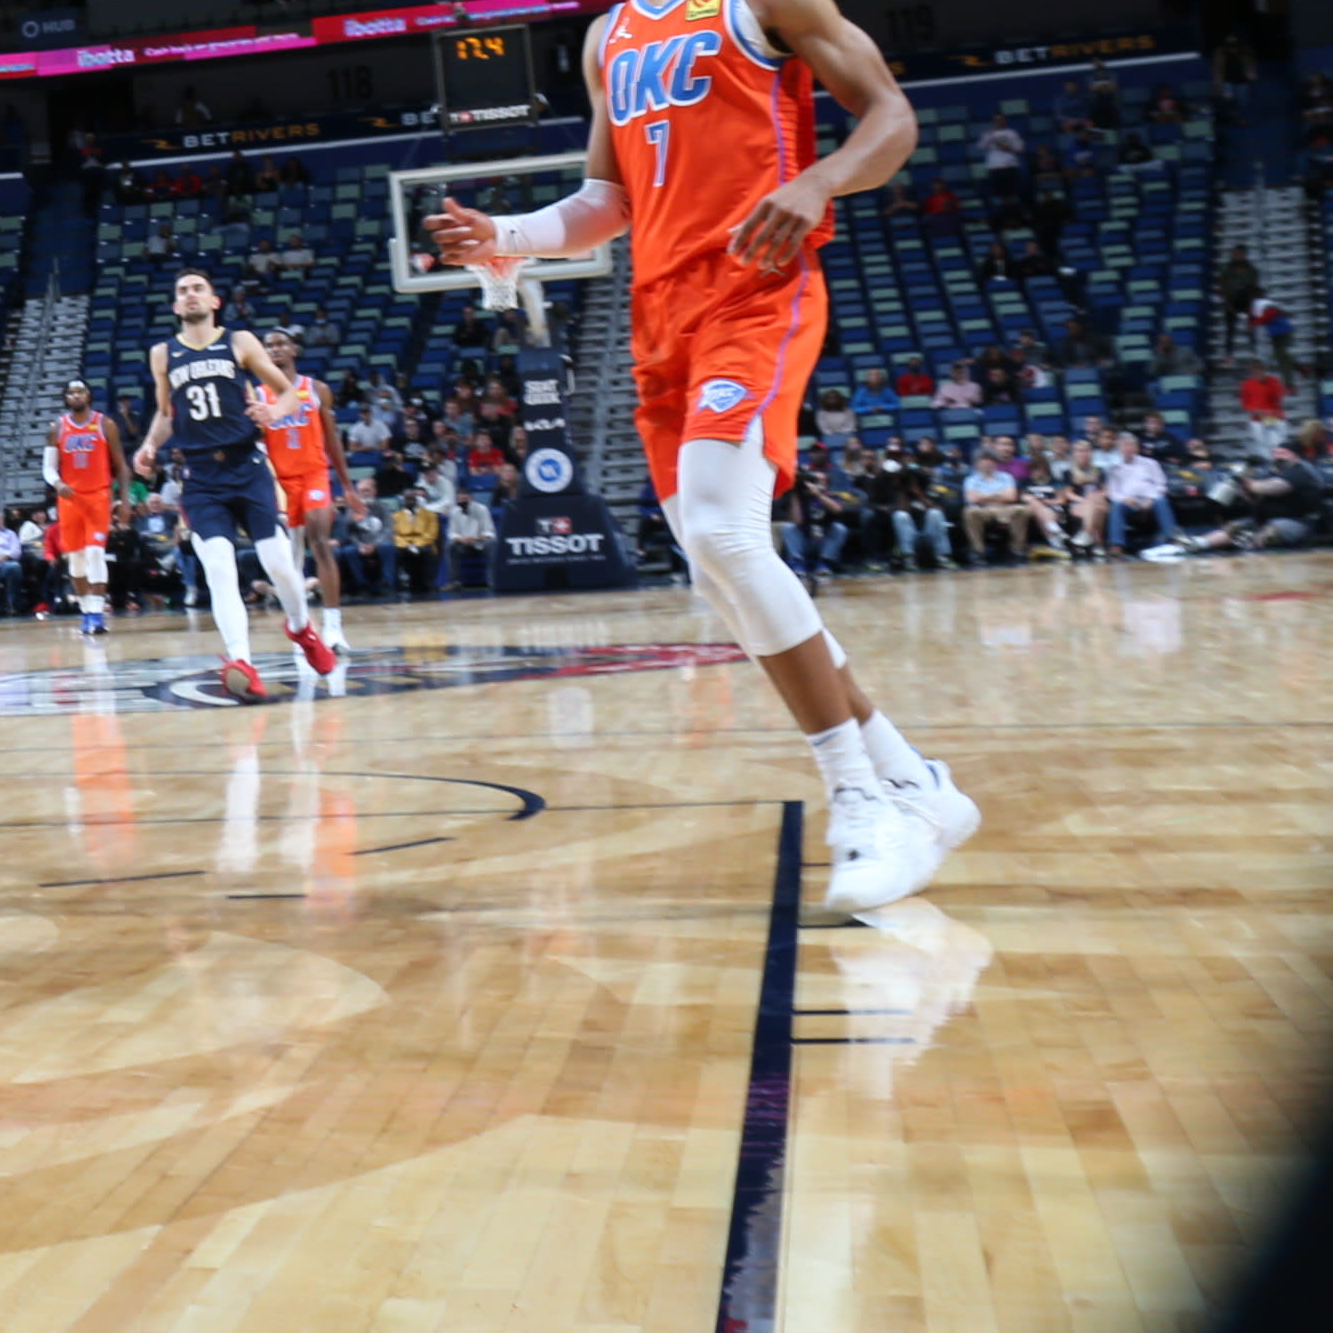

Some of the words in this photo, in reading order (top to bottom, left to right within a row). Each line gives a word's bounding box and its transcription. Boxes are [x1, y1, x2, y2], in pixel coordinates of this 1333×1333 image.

[608, 30, 723, 126] OKC
[184, 122, 321, 149] BETRIVERS
[644, 119, 670, 188] 7
[186, 382, 222, 421] 31
[505, 533, 605, 555] TISSOT
